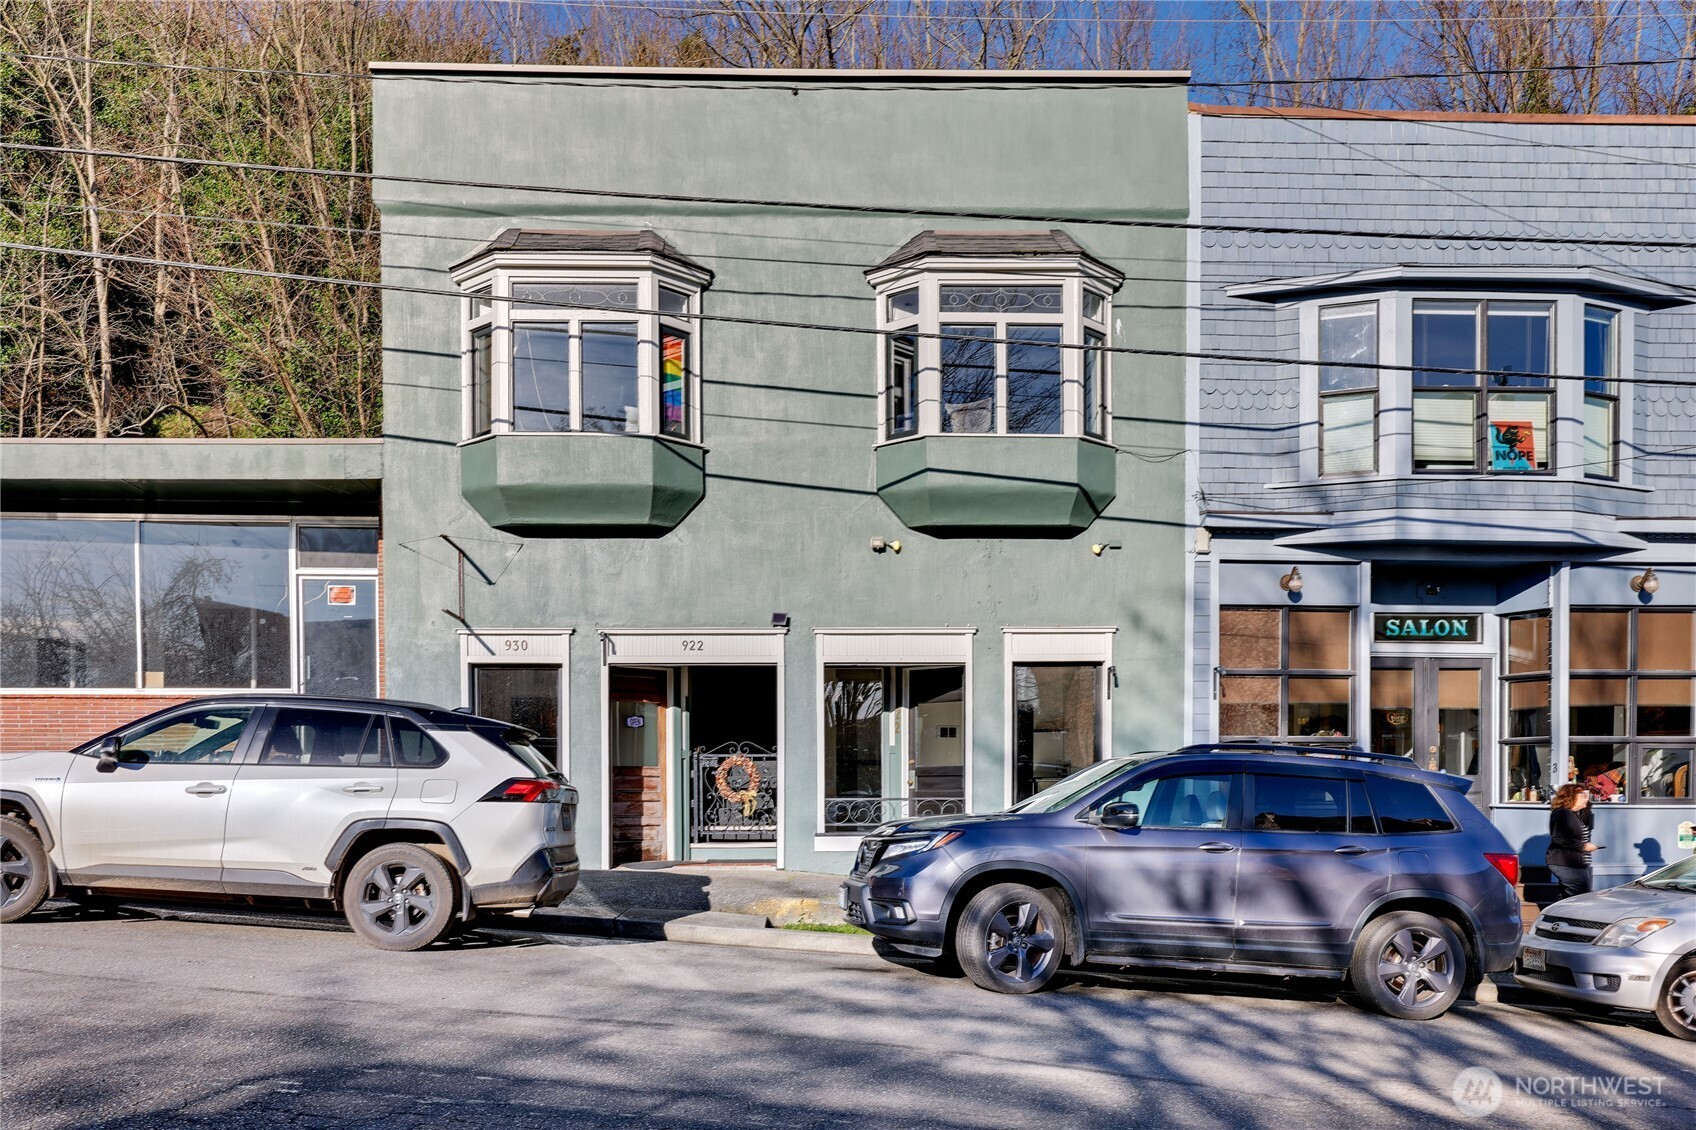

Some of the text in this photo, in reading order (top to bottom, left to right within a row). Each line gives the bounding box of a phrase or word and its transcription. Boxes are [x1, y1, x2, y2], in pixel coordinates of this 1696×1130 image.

[1495, 450, 1533, 461] NOPE
[1385, 619, 1469, 636] SALON
[504, 639, 528, 651] 930
[682, 640, 704, 651] 922
